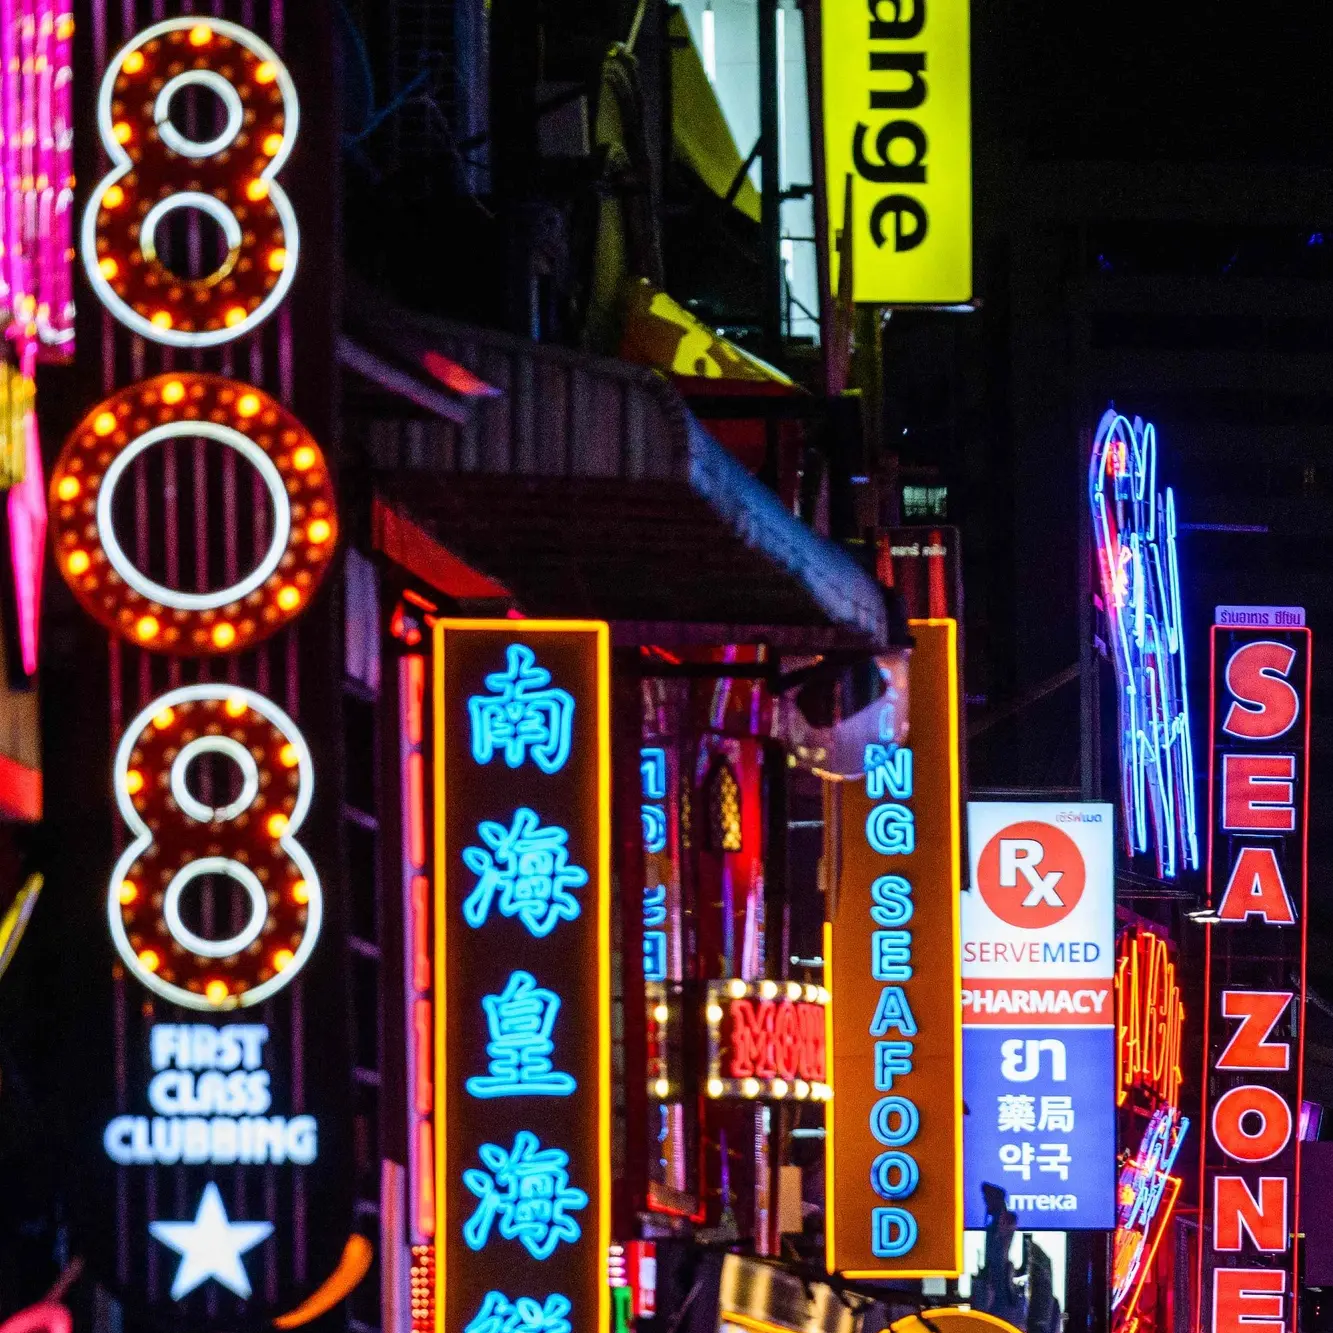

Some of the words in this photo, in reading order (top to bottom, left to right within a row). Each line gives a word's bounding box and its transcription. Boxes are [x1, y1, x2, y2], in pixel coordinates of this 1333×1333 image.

[1217, 640, 1298, 925] SEA
[999, 837, 1066, 908] Rx
[963, 941, 1100, 963] SERVEMED
[961, 989, 1109, 1014] PHARMACY
[150, 1024, 269, 1072] FIRST
[868, 874, 919, 1260] SEAFOOD
[1001, 1038, 1067, 1082] ยา
[148, 1072, 271, 1117] CLASS
[997, 1094, 1075, 1133] 藥局
[104, 1117, 318, 1166] CLUBBING
[998, 1142, 1072, 1181] 약국
[1006, 1194, 1078, 1211] птека
